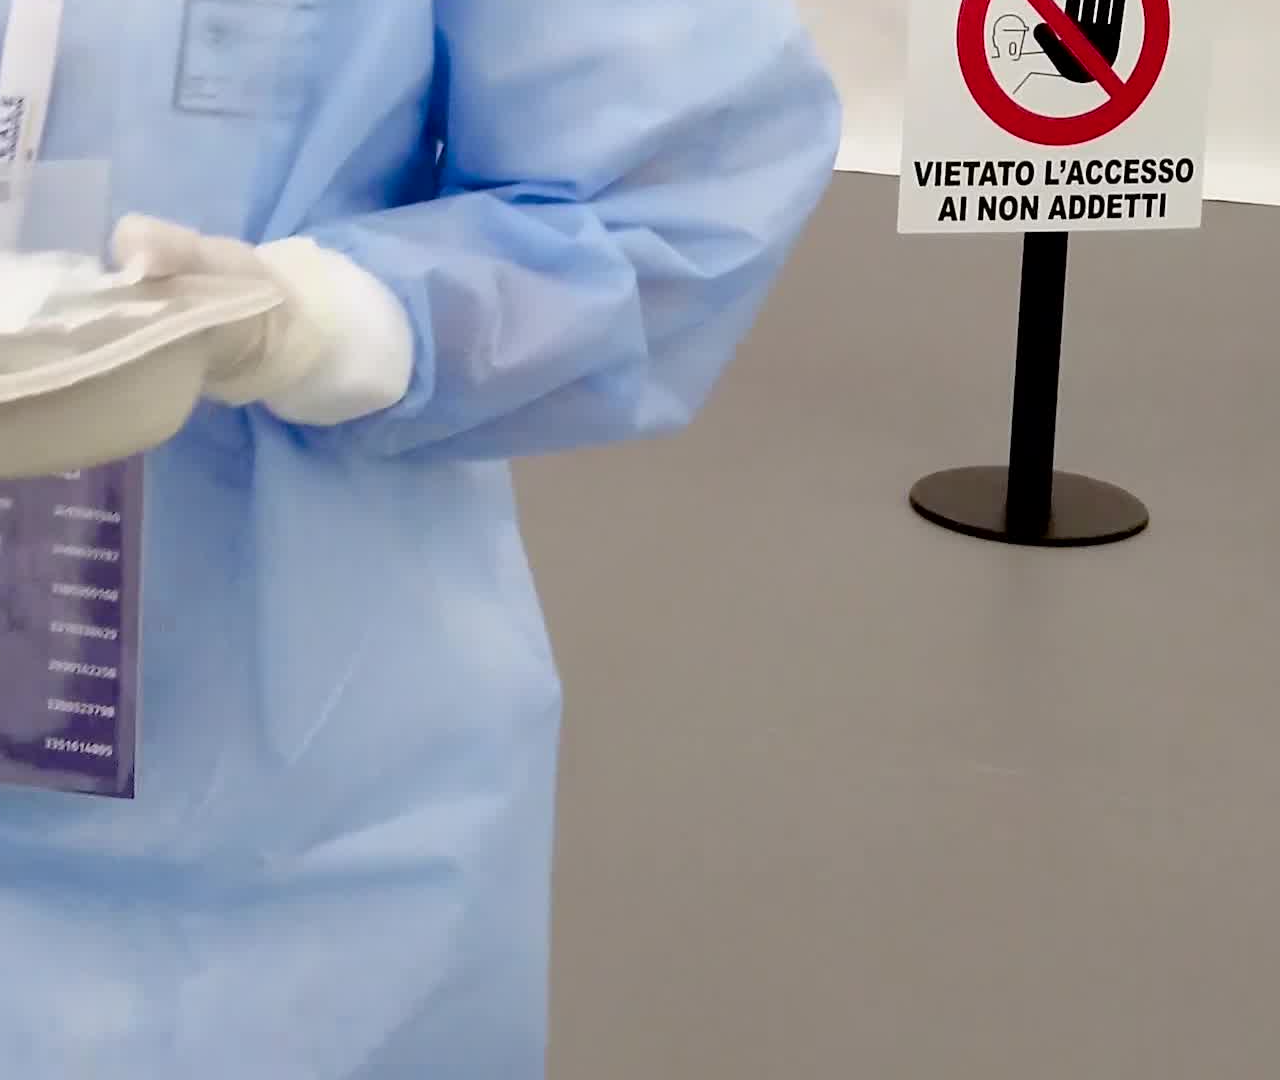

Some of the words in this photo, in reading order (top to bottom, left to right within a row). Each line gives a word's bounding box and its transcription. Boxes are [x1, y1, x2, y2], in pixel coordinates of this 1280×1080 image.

[914, 160, 1034, 187] VIETATO
[1044, 157, 1194, 186] L'ACCESSO
[938, 196, 967, 221] AI
[977, 195, 1039, 221] NON
[1048, 193, 1166, 220] ADDETTI
